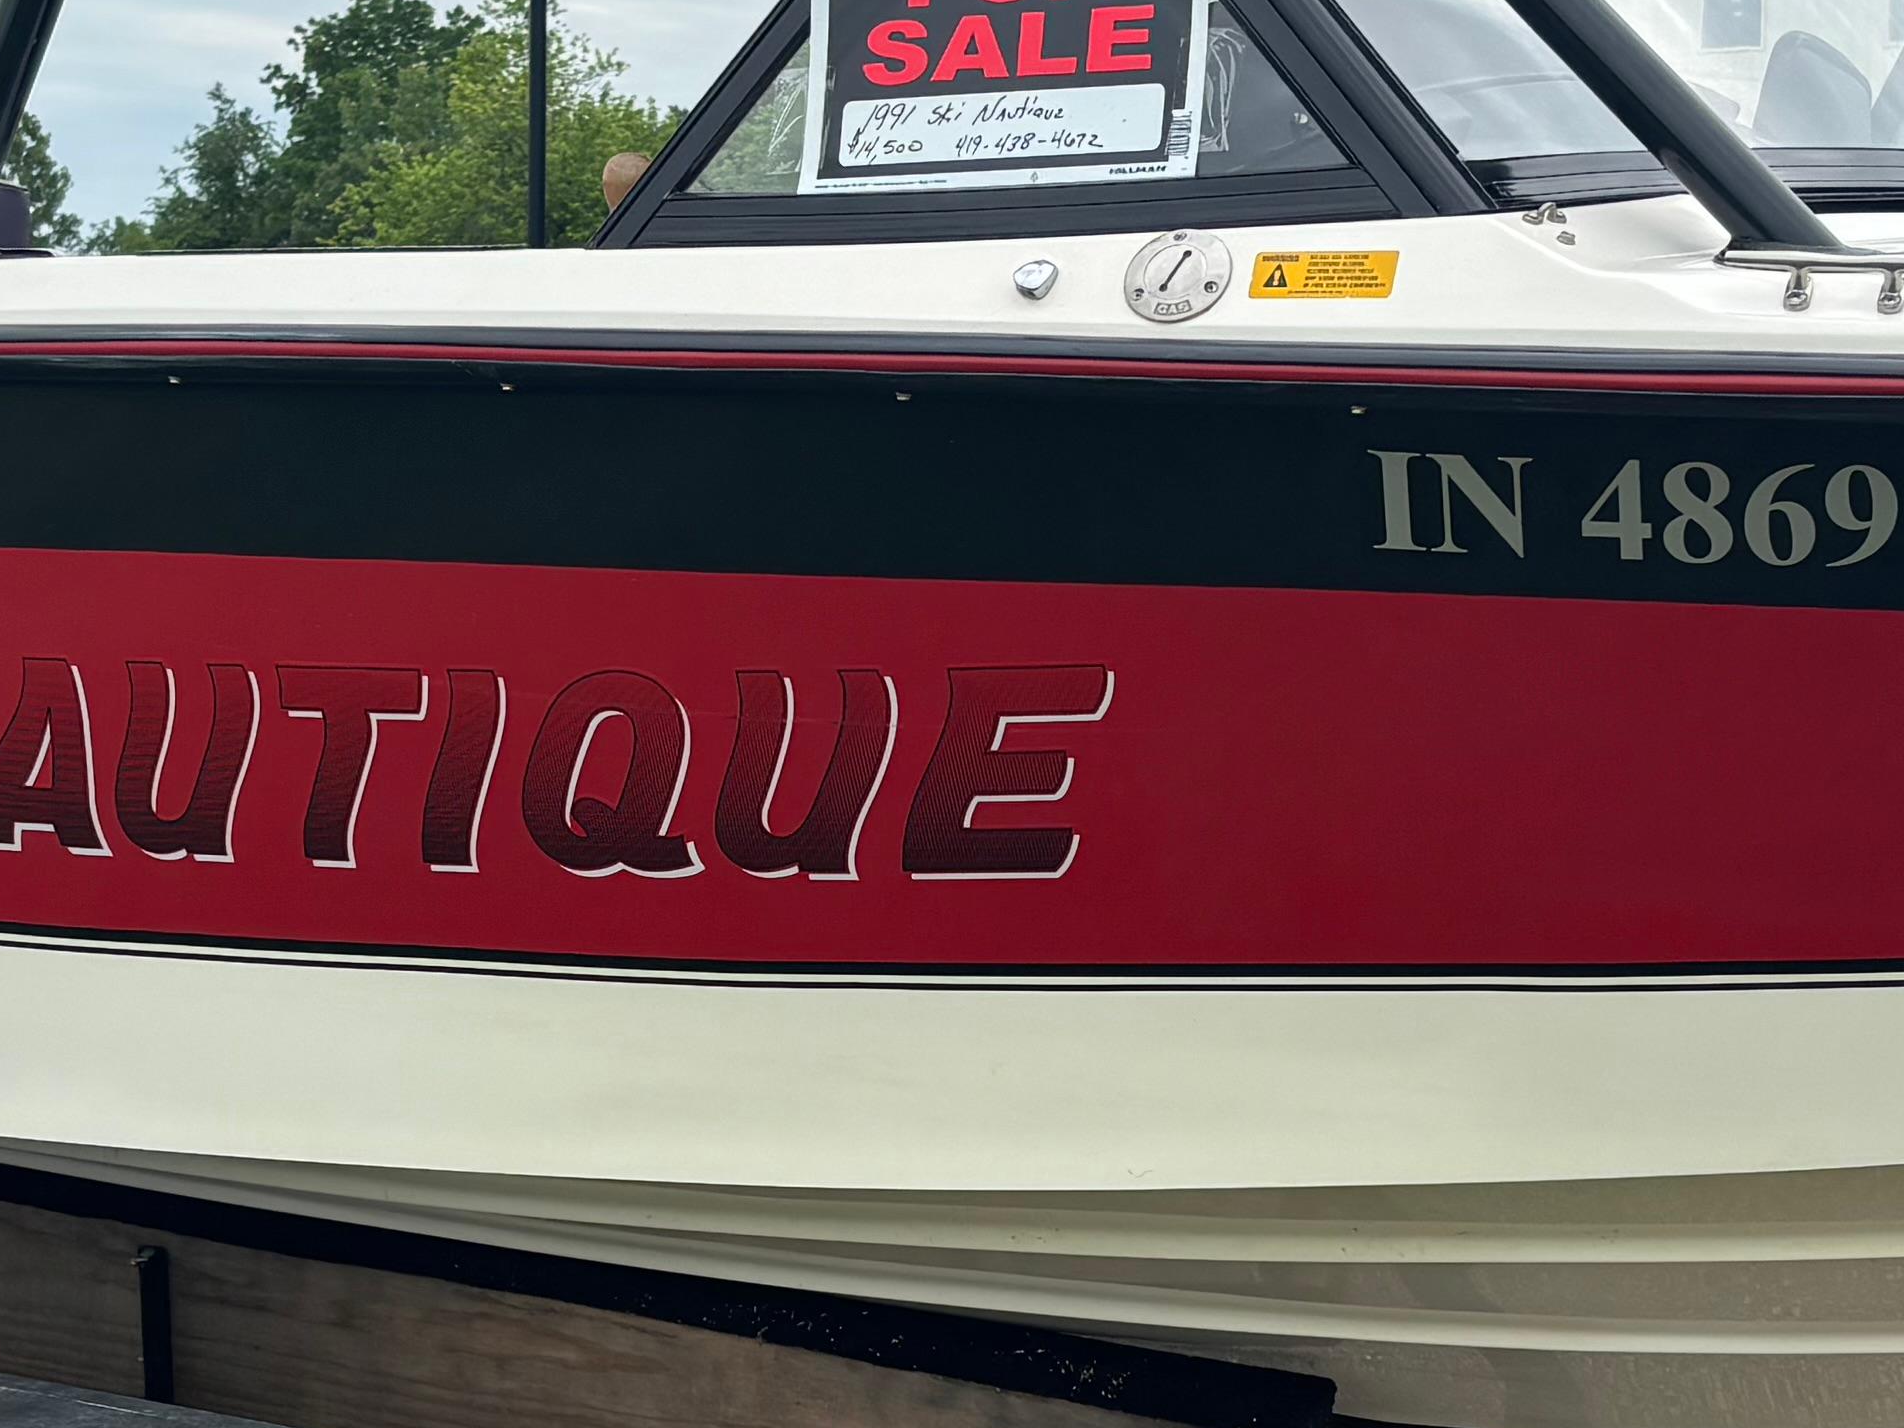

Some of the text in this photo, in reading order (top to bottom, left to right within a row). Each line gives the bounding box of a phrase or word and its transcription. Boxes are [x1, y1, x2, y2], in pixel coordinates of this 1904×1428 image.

[862, 3, 1156, 86] SALE
[860, 103, 917, 133] 1991
[1366, 448, 1534, 558] IN
[1580, 458, 1899, 567] 4869
